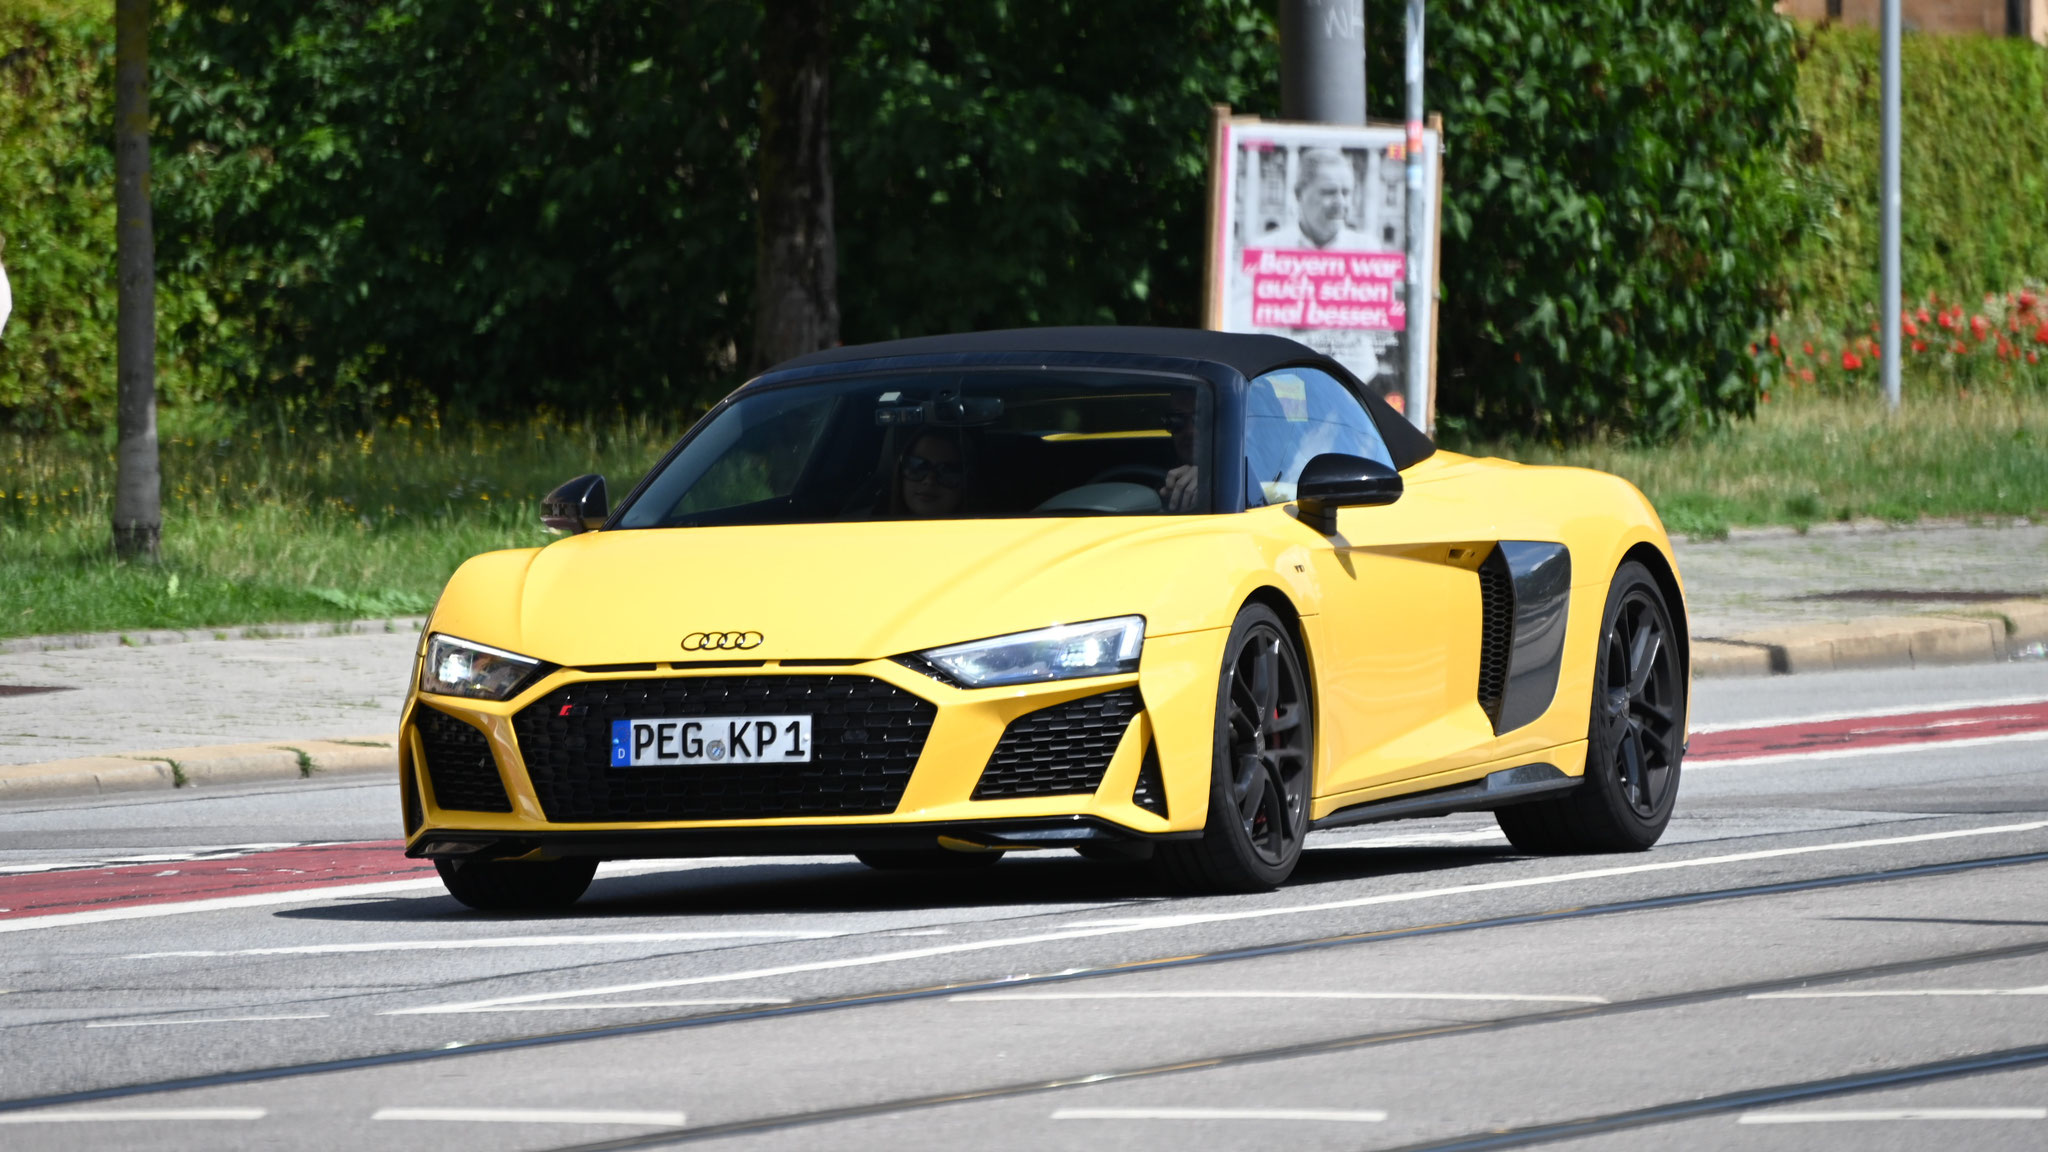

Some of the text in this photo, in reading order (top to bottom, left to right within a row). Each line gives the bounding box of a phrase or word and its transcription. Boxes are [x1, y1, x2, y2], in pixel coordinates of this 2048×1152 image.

[1350, 257, 1403, 278] war
[1257, 275, 1388, 302] auch schon
[1256, 300, 1305, 325] mal
[633, 721, 705, 760] PEG
[617, 747, 626, 760] D
